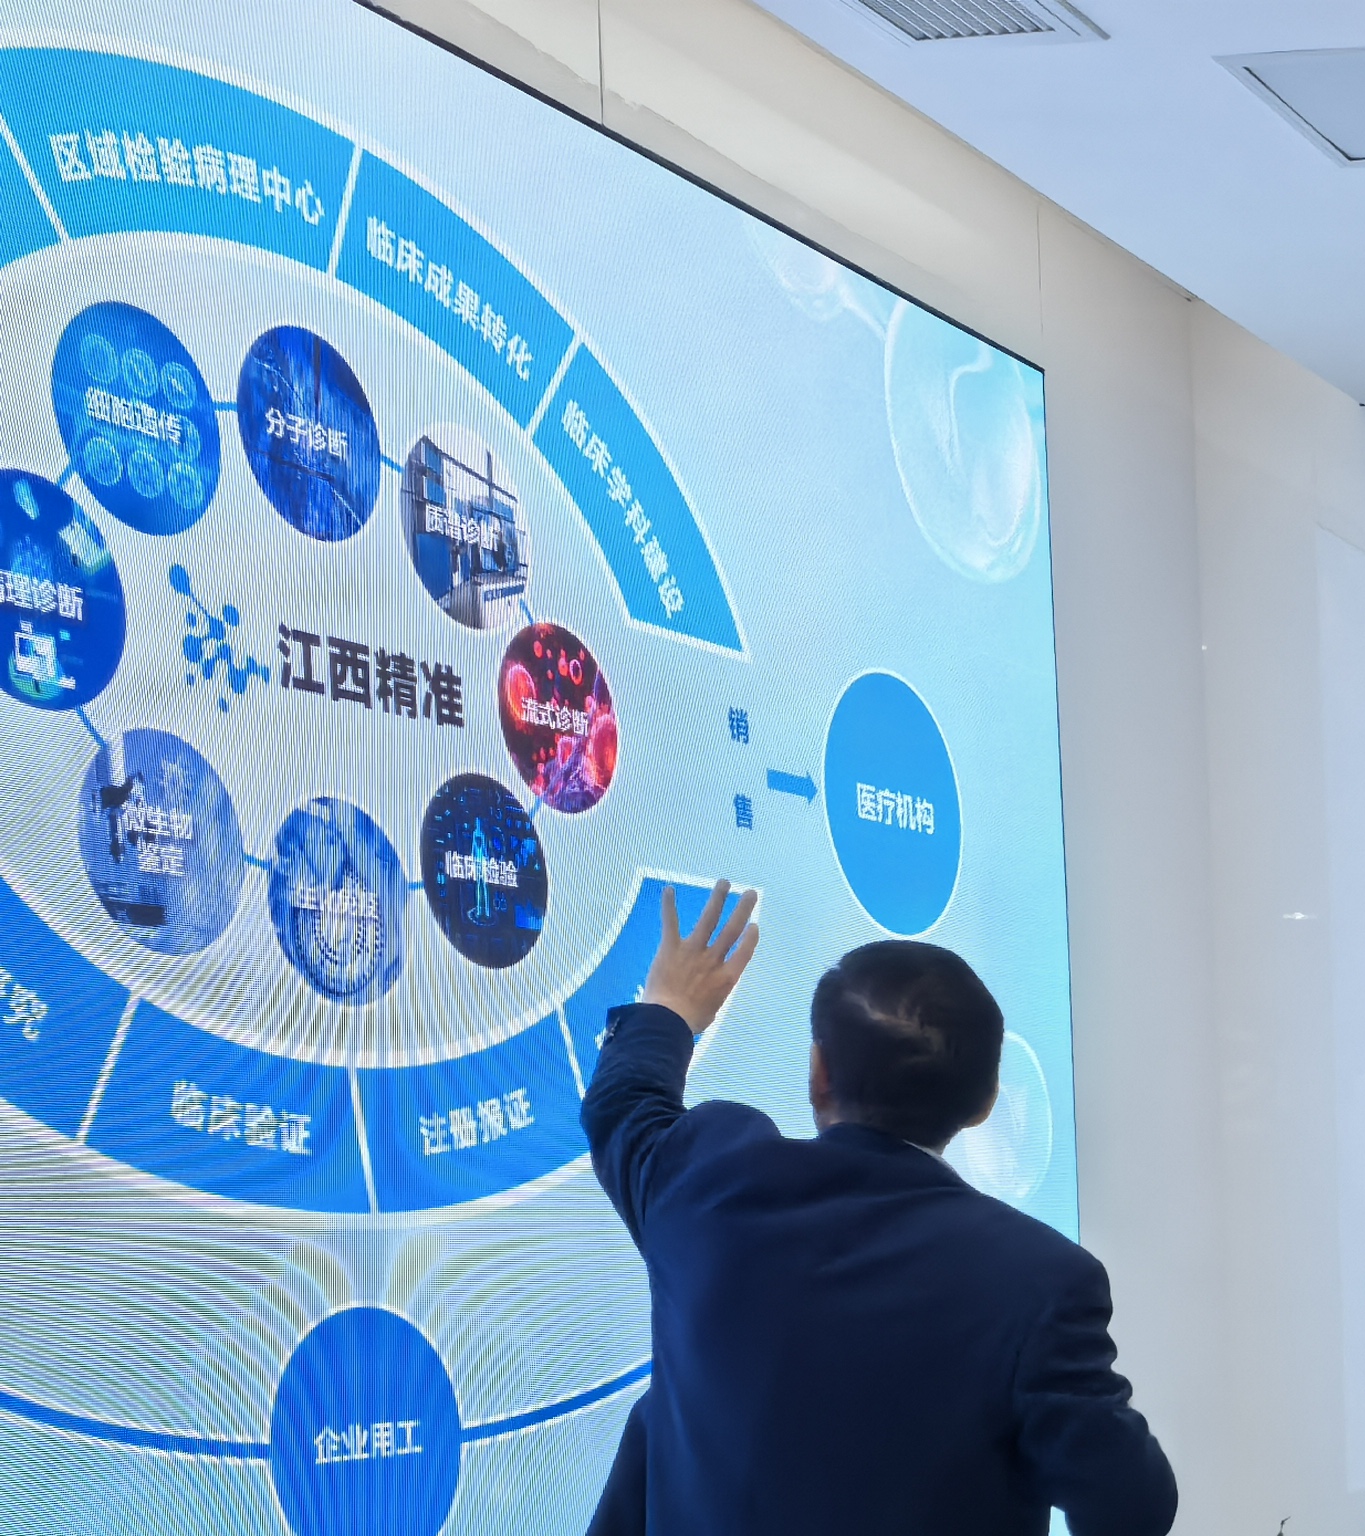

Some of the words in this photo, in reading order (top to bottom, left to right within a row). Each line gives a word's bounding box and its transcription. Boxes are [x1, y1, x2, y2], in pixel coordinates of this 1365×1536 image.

[49, 128, 325, 226] 区域检验病理中心
[366, 215, 534, 382] 临床成果转化
[265, 407, 348, 460] 分子诊断
[561, 400, 685, 619] 临床学科建设
[278, 622, 465, 728] 江西精准
[521, 697, 588, 737] 流式诊断
[856, 782, 935, 835] 医疗机构
[444, 850, 519, 888] 临床检验
[418, 1087, 536, 1157] 注册报证
[314, 1419, 423, 1465] 企业用工
